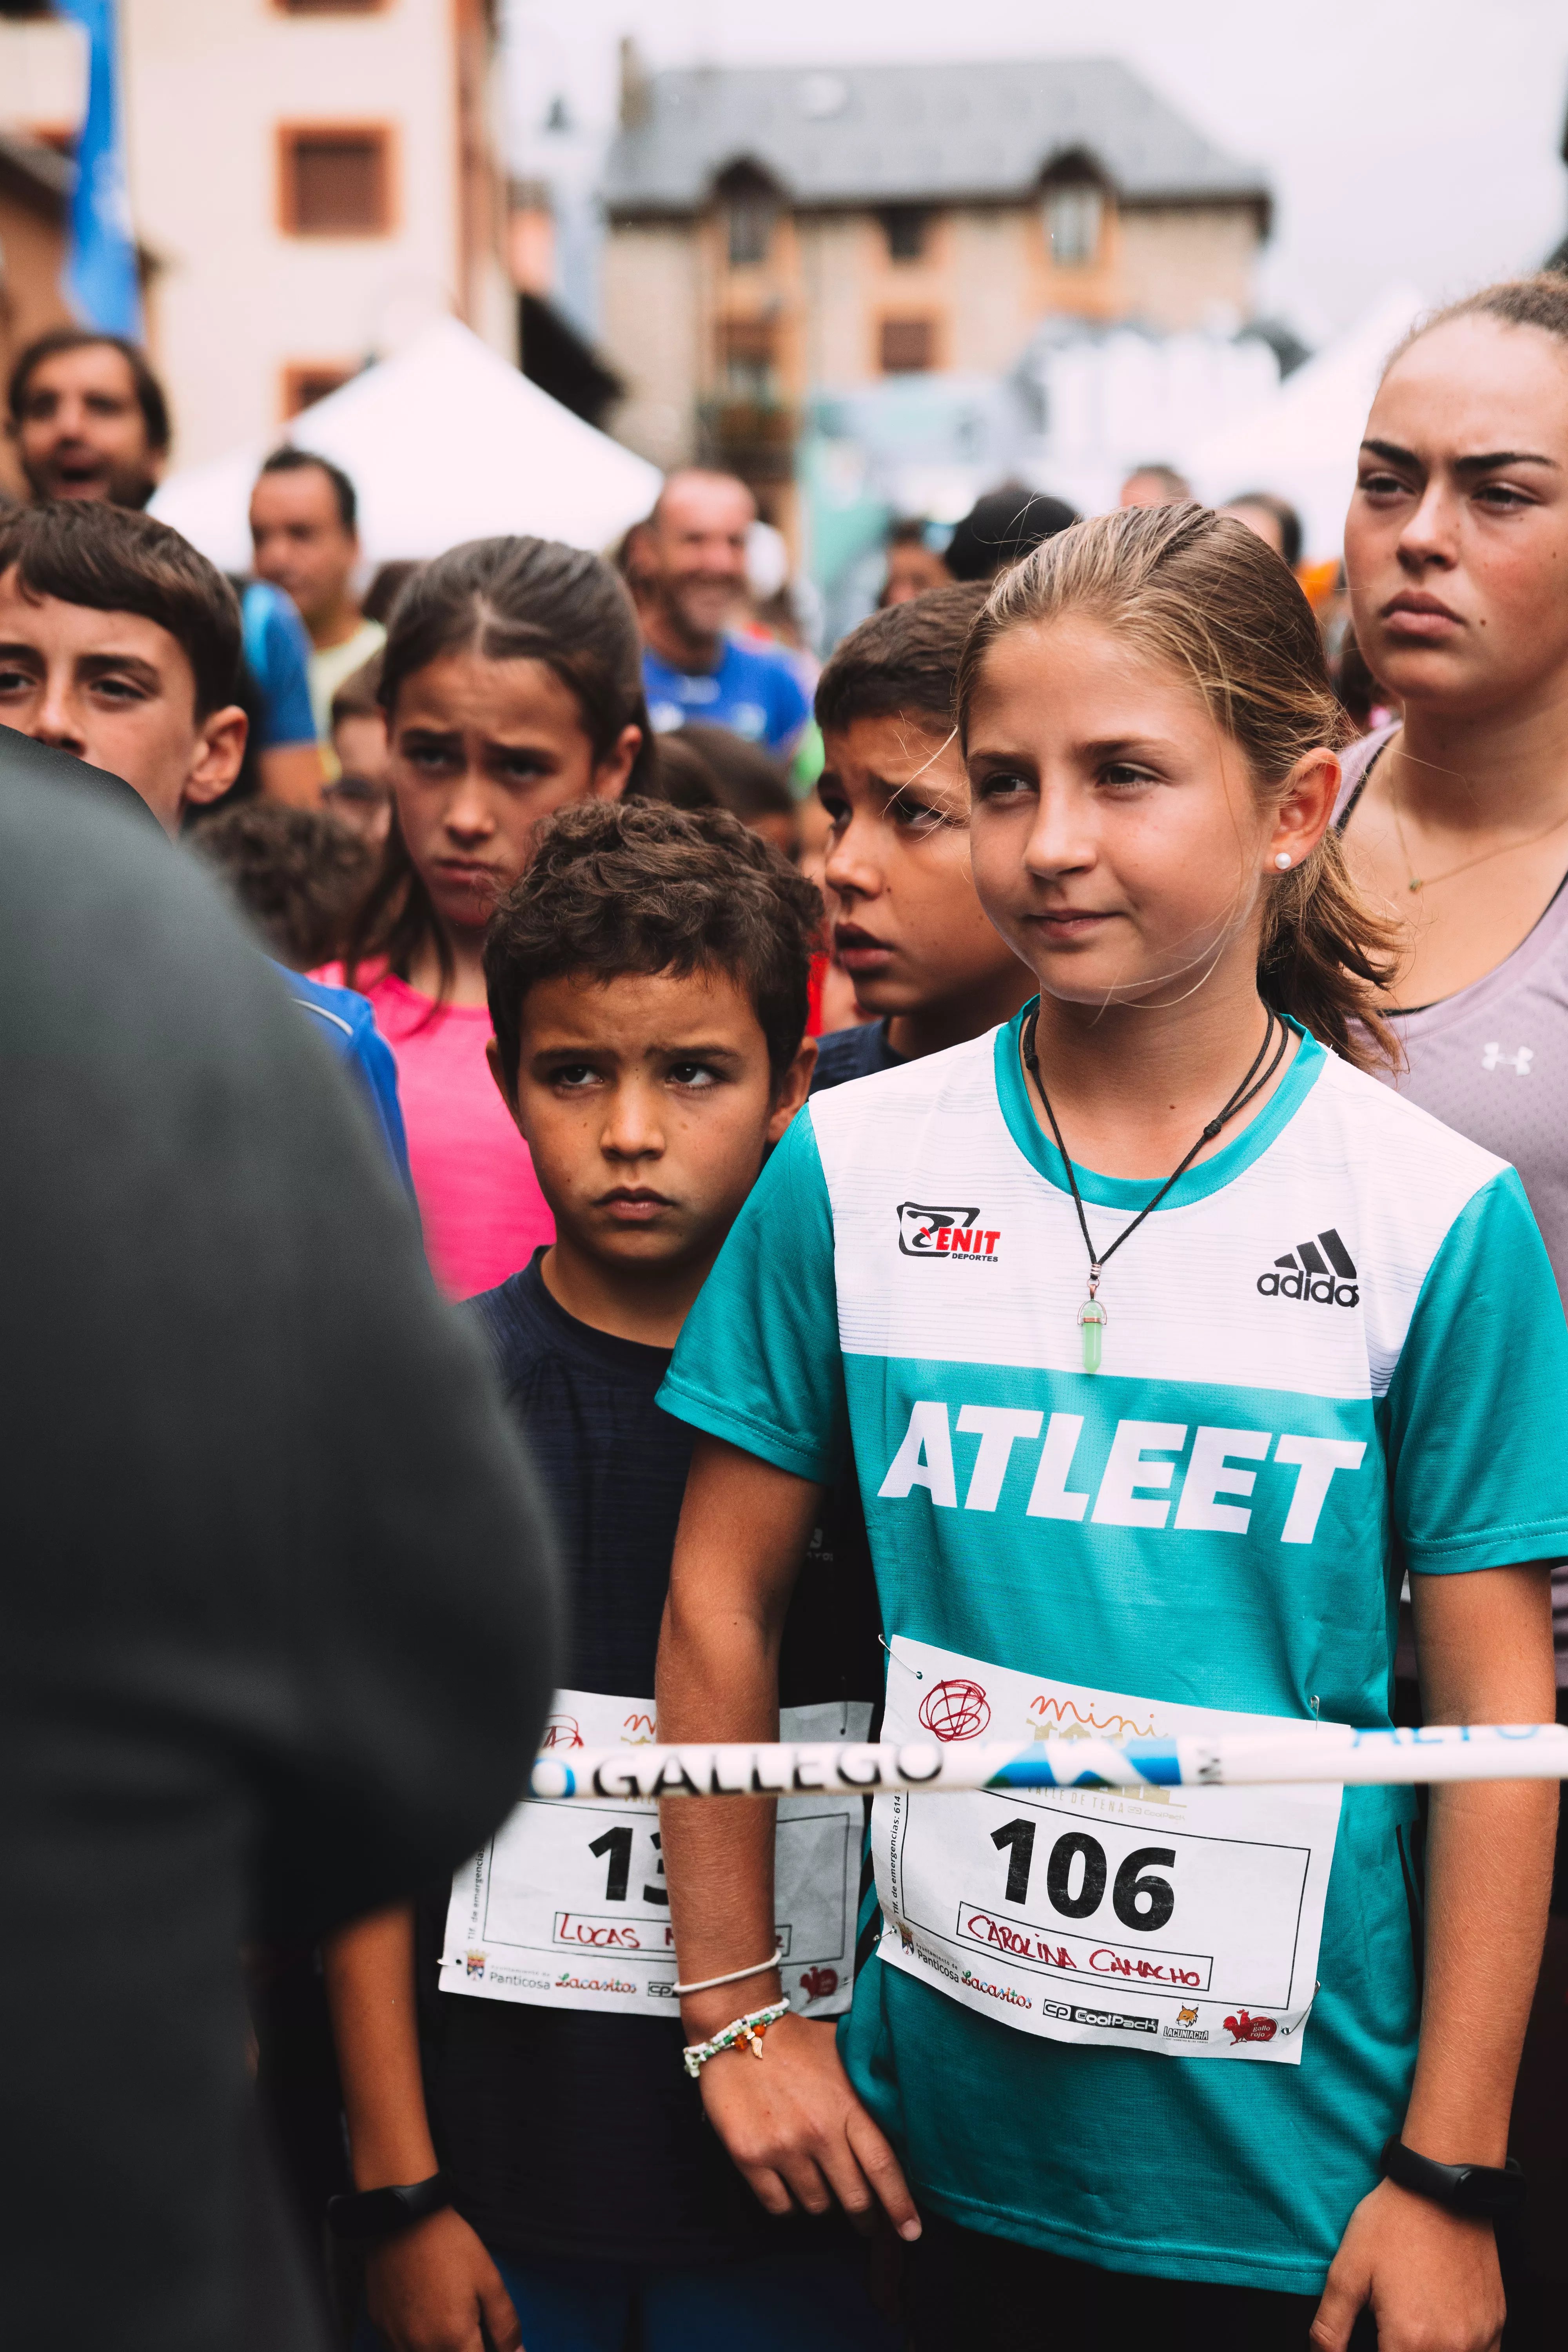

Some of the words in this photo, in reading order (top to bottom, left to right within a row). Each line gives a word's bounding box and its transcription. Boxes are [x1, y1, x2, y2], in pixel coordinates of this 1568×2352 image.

[952, 1253, 998, 1262] DEPORTES
[1257, 1270, 1359, 1307] adidas
[877, 1401, 1367, 1544] ATLEET
[1030, 1695, 1169, 1739] mini
[592, 1745, 942, 1797] GALLEGO
[1071, 1792, 1085, 1805] DE
[1093, 1797, 1123, 1813] TENA
[890, 1817, 900, 1884] emergencias:
[990, 1818, 1176, 1931] 106
[891, 1886, 897, 1898] de
[560, 1913, 640, 1948] LUCAS
[916, 1943, 949, 1965] Ayuntamiento
[918, 1949, 958, 1983] Panticosa
[968, 1915, 1077, 1968] CAROLINA
[1089, 1949, 1200, 1986] CAMACHO
[490, 1972, 550, 1989] Panticosa
[555, 1973, 637, 1994] Lacasitos
[961, 1970, 1032, 2009] Lacasitos
[1075, 2009, 1156, 2031] CoolPack
[1163, 2026, 1209, 2040] LACUNIACHA
